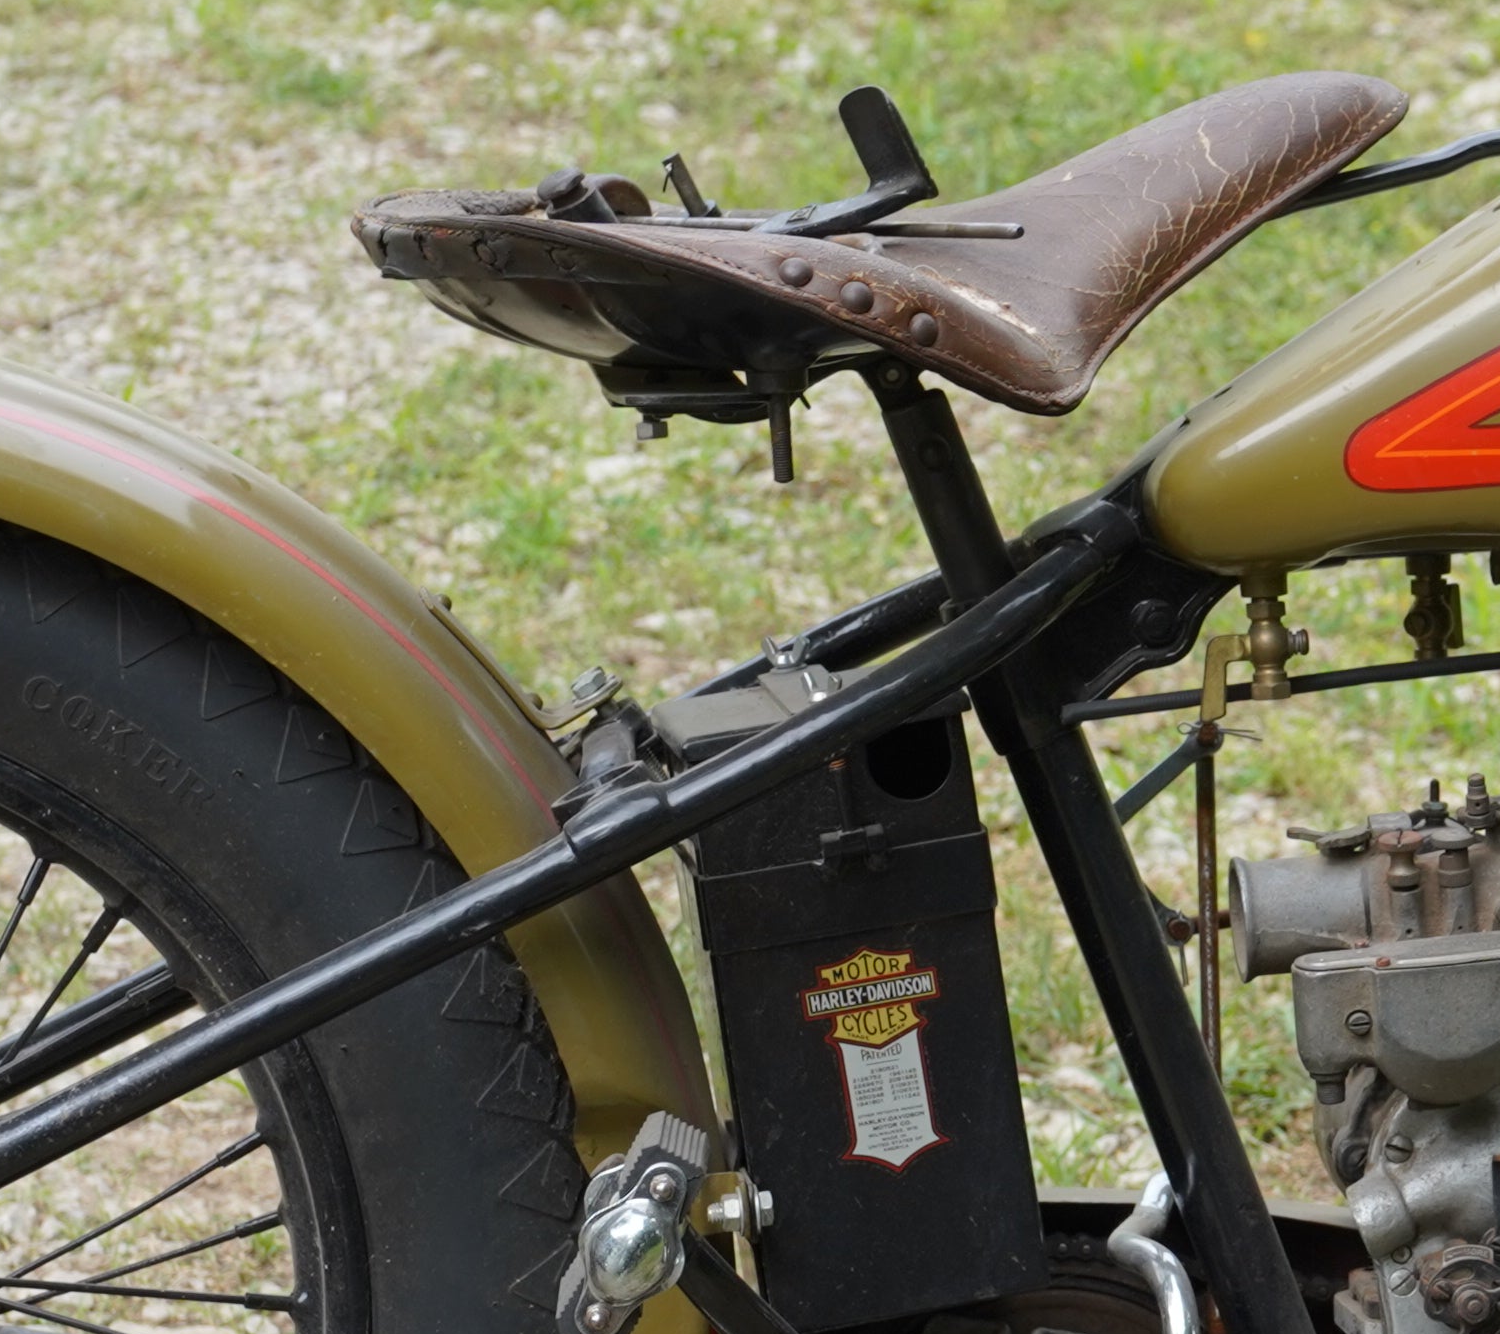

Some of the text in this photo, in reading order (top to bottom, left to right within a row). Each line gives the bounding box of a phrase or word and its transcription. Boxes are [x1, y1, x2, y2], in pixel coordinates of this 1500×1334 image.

[21, 673, 215, 804] COKER
[832, 953, 900, 982] MOTOR
[809, 974, 931, 1012] HARLEY-DAVIDSON
[841, 1005, 907, 1036] CYCLES
[860, 1043, 902, 1061] PATENTED
